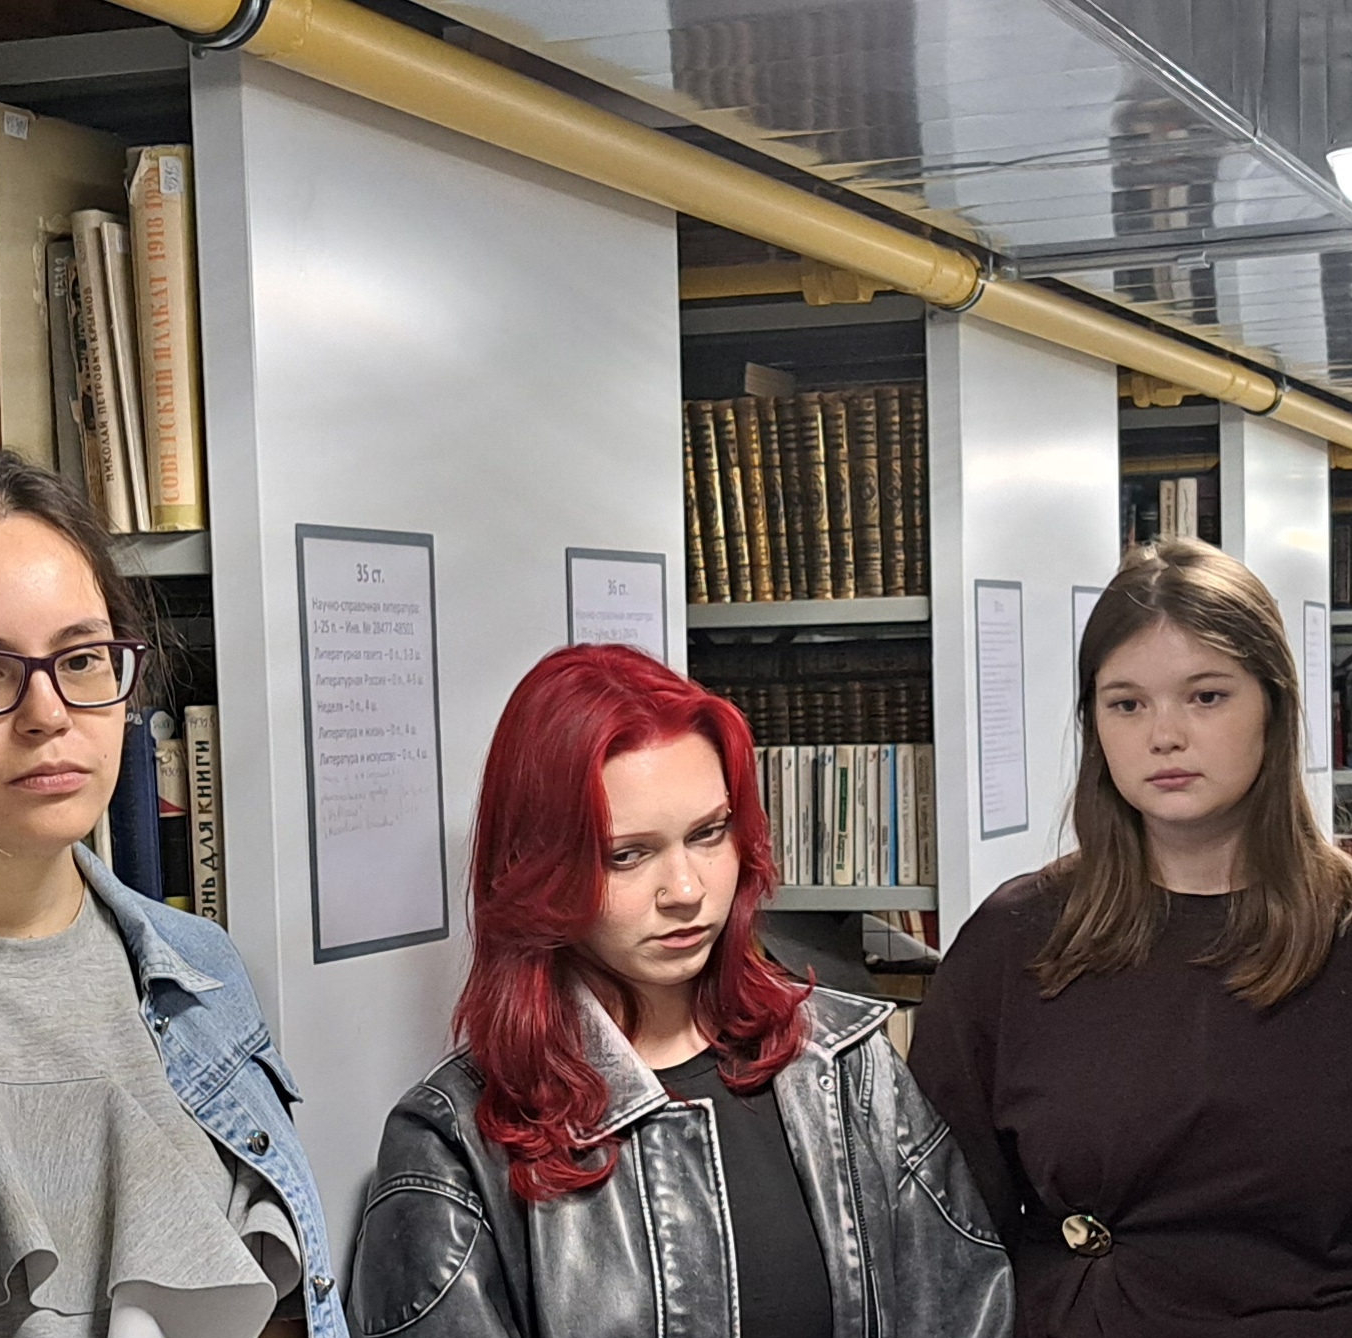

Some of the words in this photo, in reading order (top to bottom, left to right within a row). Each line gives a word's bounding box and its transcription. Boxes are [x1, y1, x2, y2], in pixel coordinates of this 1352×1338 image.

[147, 209, 166, 261] 1918
[83, 285, 100, 347] КРЫМОВ
[151, 275, 171, 363] ПЛАКАТ
[92, 348, 108, 414] ПЕТРОВИЧ
[99, 418, 116, 483] НИКОЛАЙ
[153, 368, 181, 504] СОВЕТСКИЙ
[356, 563, 369, 583] 35
[371, 569, 385, 584] ст.
[194, 740, 213, 815] КНИГИ
[198, 821, 219, 872] ДЛЯ
